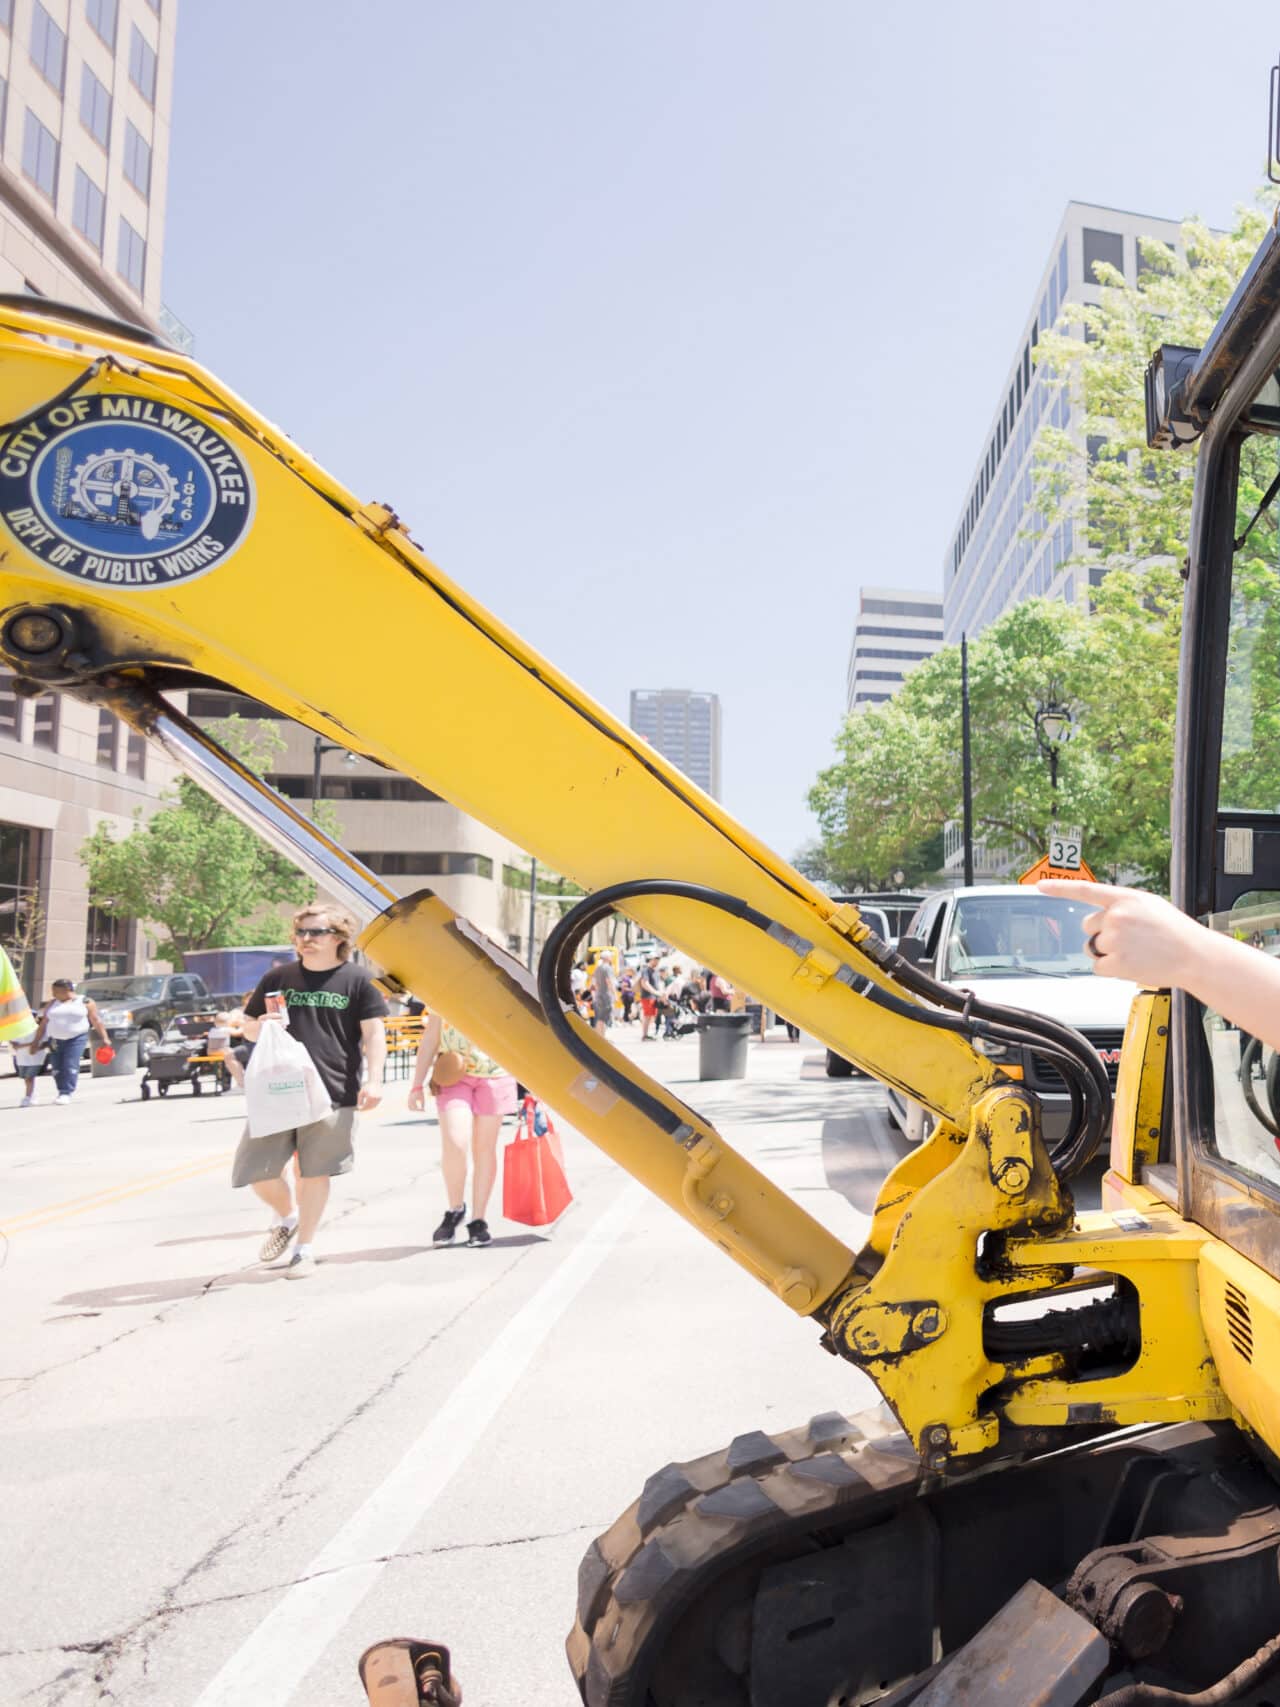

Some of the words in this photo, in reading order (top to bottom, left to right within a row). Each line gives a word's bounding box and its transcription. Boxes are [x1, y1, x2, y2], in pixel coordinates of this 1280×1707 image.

[0, 422, 47, 478] CITY
[48, 400, 90, 427] OF
[101, 397, 245, 506] MILWAUKEE
[7, 507, 55, 552] DEPT.
[48, 543, 82, 567] OF
[81, 555, 157, 583] PUBLIC
[159, 535, 225, 578] WORKS
[1053, 824, 1081, 838] NTH
[1052, 842, 1078, 864] 32
[1040, 870, 1087, 880] DET
